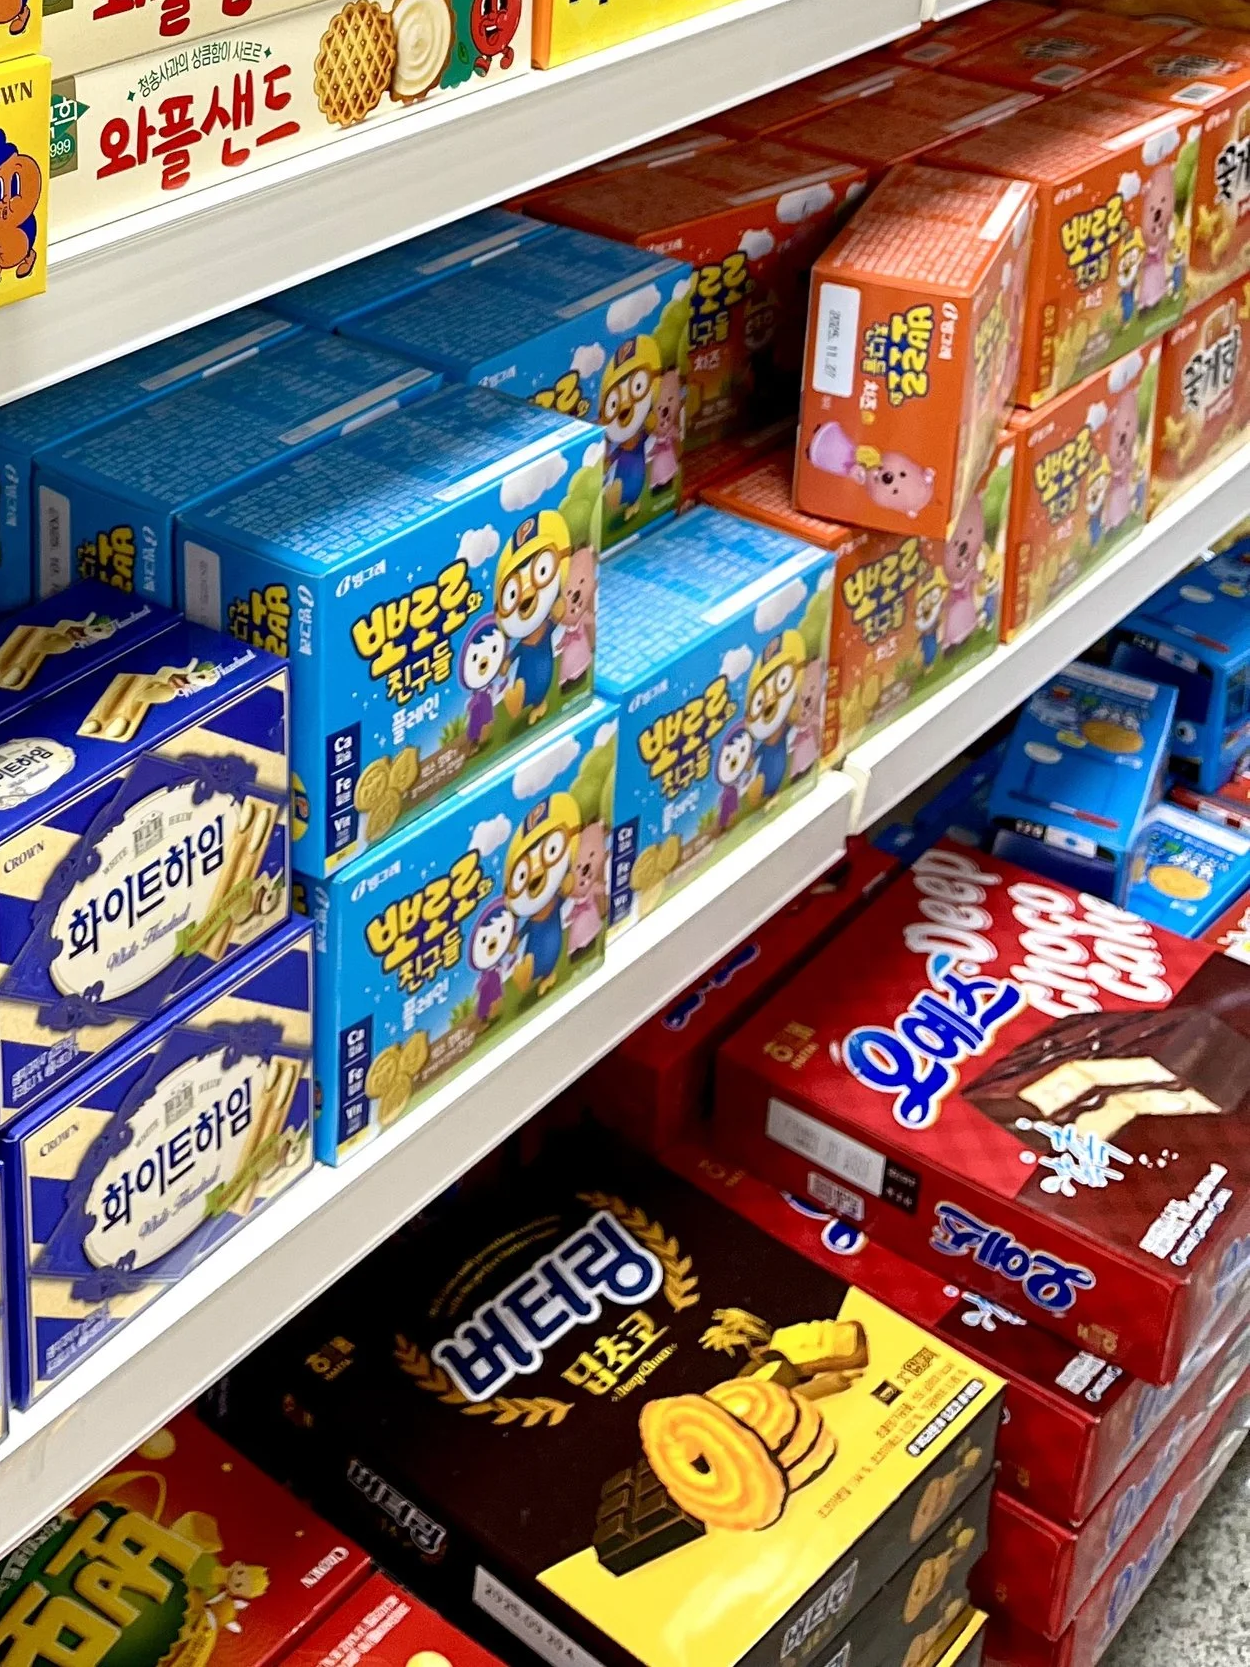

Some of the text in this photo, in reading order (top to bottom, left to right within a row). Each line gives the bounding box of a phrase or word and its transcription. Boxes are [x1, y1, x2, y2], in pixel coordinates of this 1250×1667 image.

[96, 63, 302, 191] 와플샌드
[387, 640, 453, 705] 친구들
[391, 692, 441, 746] 플레인
[334, 735, 352, 754] Ca
[335, 776, 352, 795] Fe
[66, 813, 227, 963] 화이트하임
[843, 971, 1028, 1129] 오예스
[100, 1077, 255, 1235] 화이트하임
[431, 1210, 664, 1403] 버터링
